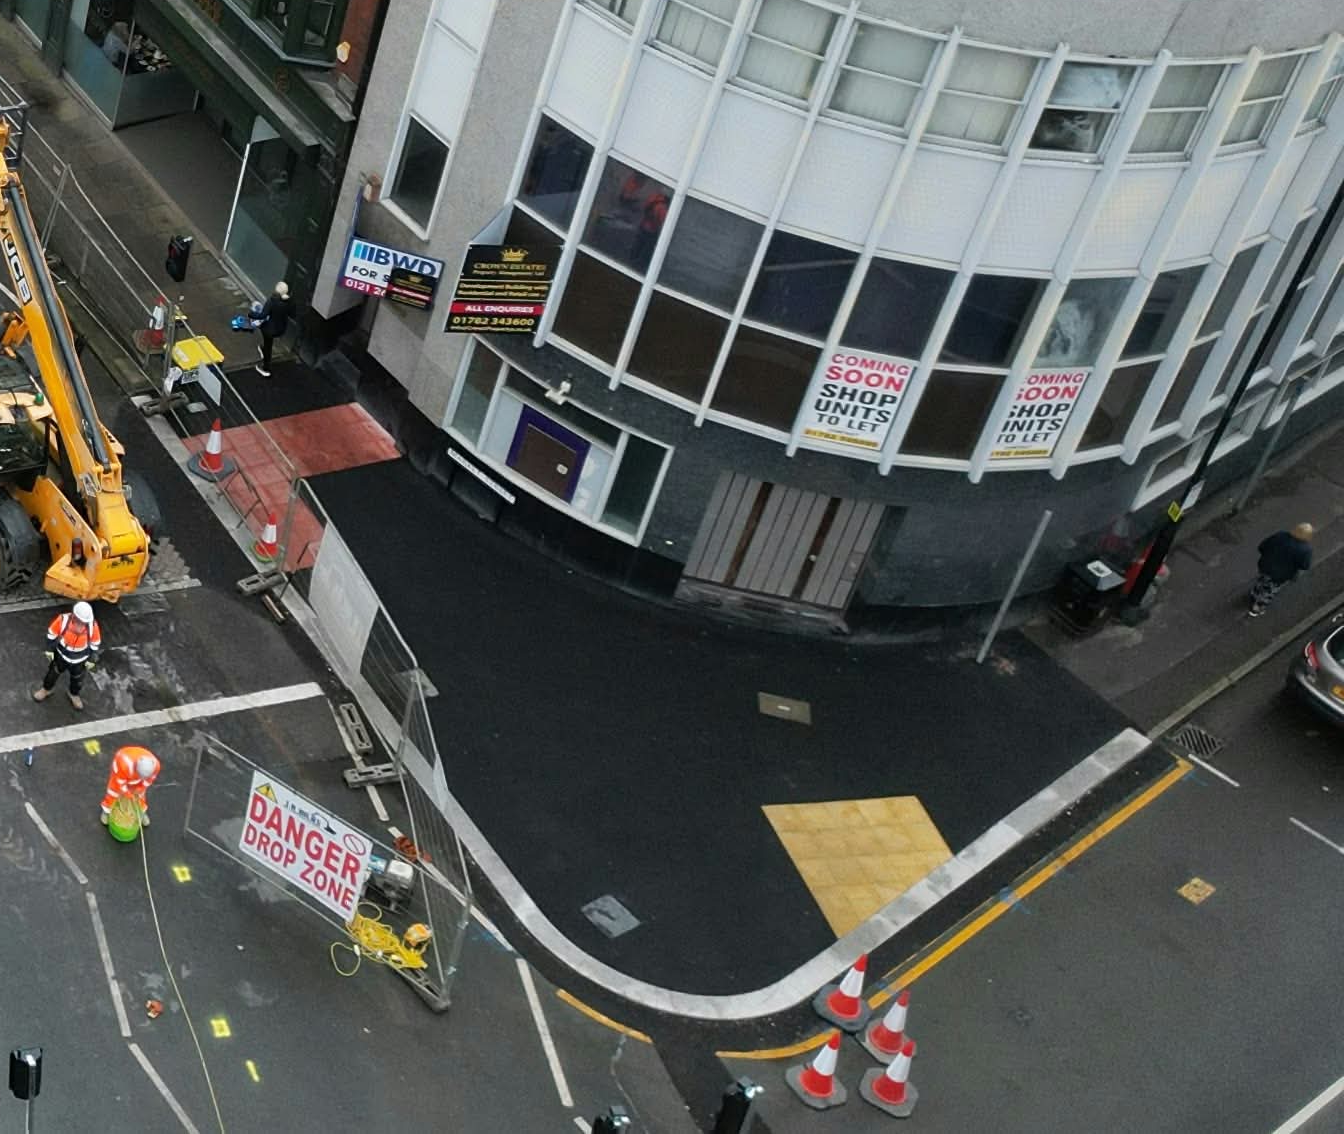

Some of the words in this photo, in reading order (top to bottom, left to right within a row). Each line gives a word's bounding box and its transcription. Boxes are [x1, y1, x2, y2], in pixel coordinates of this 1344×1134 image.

[4, 238, 32, 304] JCB
[352, 266, 378, 280] FOR
[345, 279, 370, 292] 0121
[465, 305, 483, 313] ALL
[484, 306, 534, 314] ENQUIRIES
[452, 316, 489, 325] 01782
[831, 353, 910, 376] COMING
[825, 366, 905, 392] SOON
[1025, 373, 1085, 385] OMING
[819, 383, 897, 407] SHOP
[814, 398, 892, 423] UNITS
[816, 413, 840, 426] TO
[847, 420, 881, 433] LET
[1021, 432, 1052, 443] LET
[250, 792, 361, 886] DANGER
[244, 823, 297, 868] DROP
[299, 860, 355, 911] ZONE
